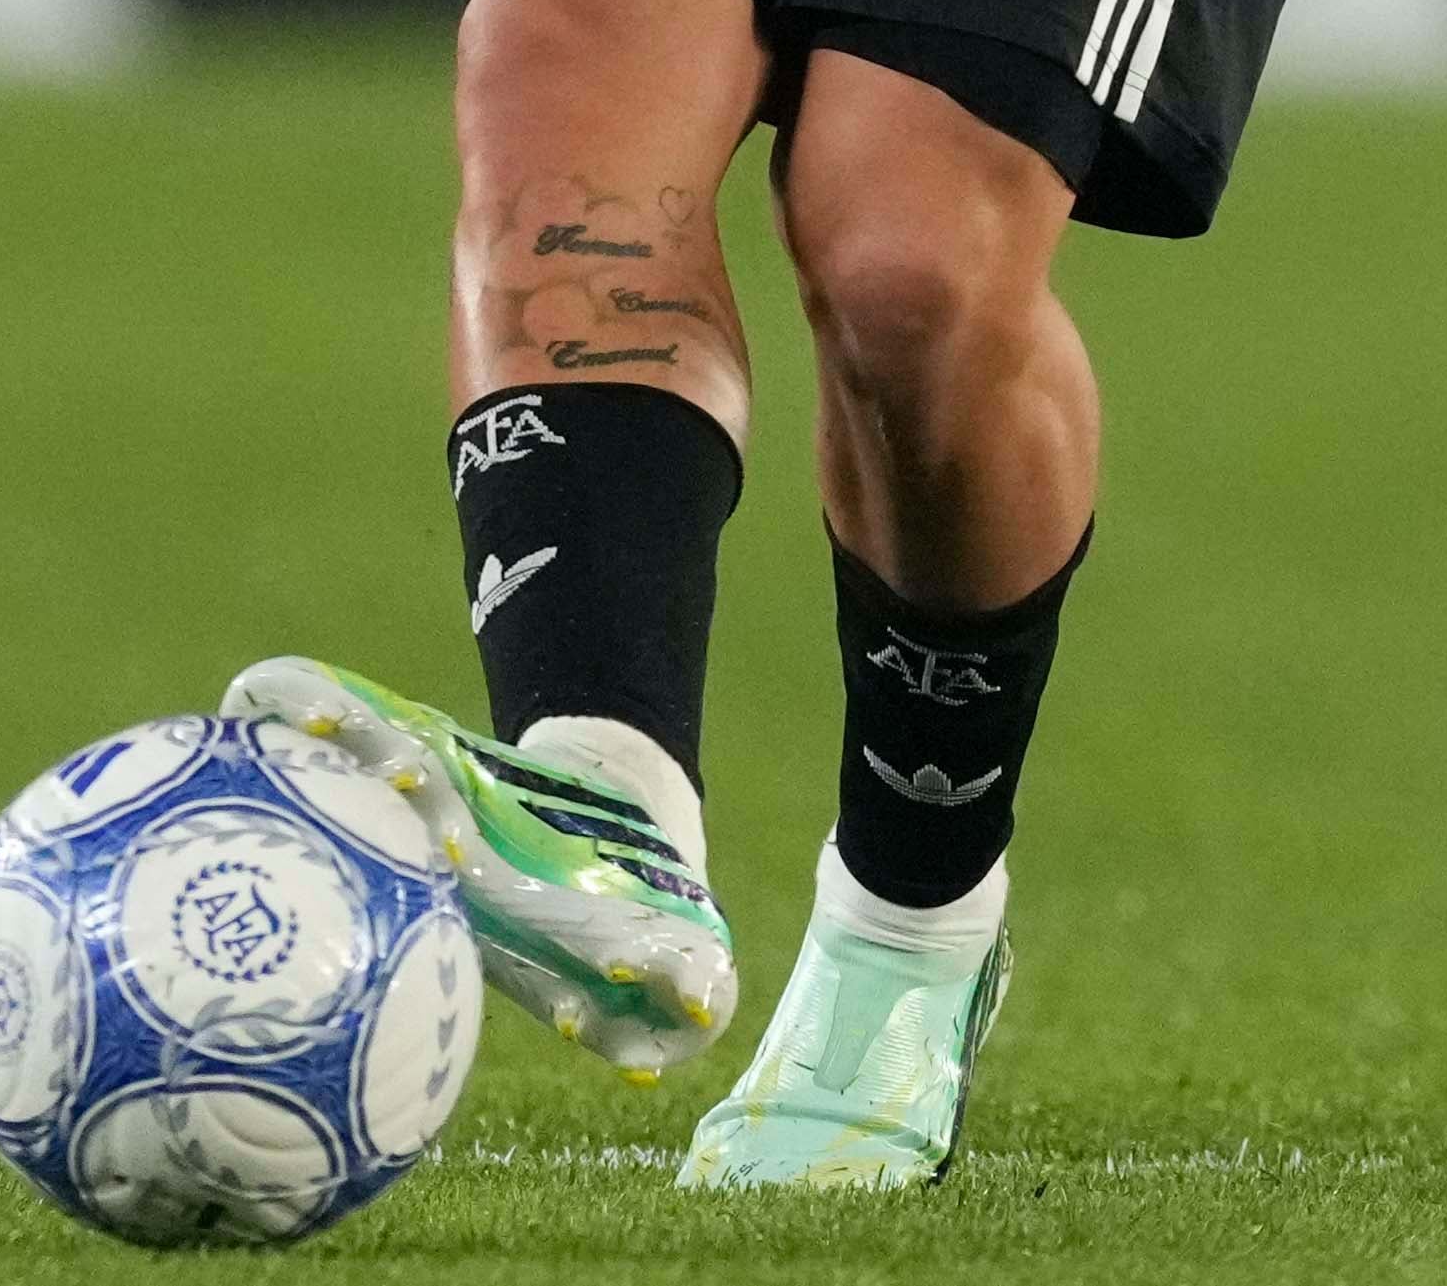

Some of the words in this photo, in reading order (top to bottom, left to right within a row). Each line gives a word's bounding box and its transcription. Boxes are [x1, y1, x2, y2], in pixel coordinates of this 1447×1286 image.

[454, 393, 567, 502] AFA
[865, 625, 1002, 707] AFA
[193, 881, 281, 968] AFA
